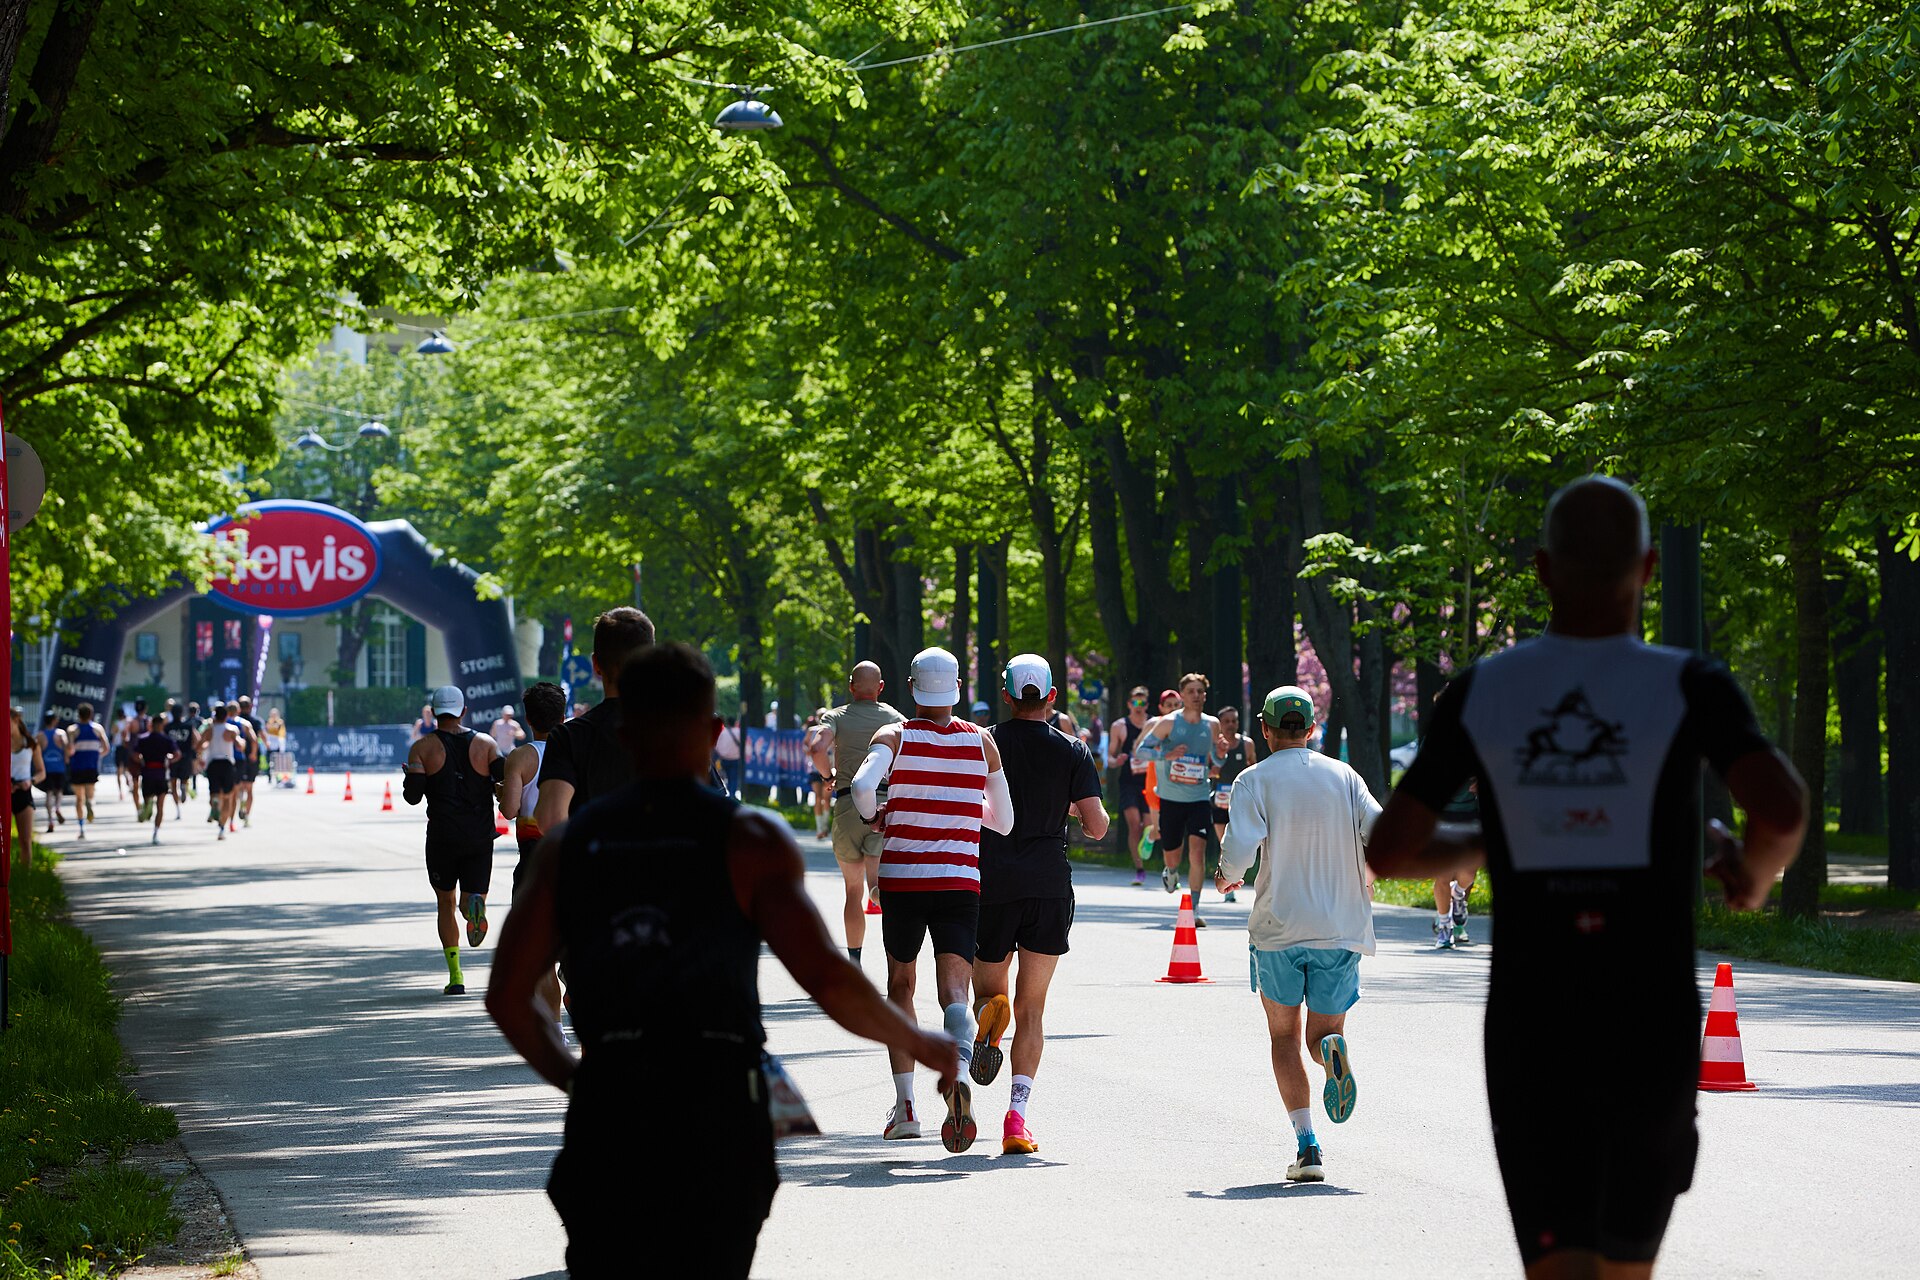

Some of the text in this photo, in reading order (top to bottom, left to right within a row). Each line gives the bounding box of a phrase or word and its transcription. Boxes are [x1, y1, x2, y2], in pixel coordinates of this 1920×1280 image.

[60, 653, 105, 675] STORE
[460, 653, 505, 675] STORE
[55, 679, 107, 702] ONLINE
[465, 678, 516, 700] ONLINE
